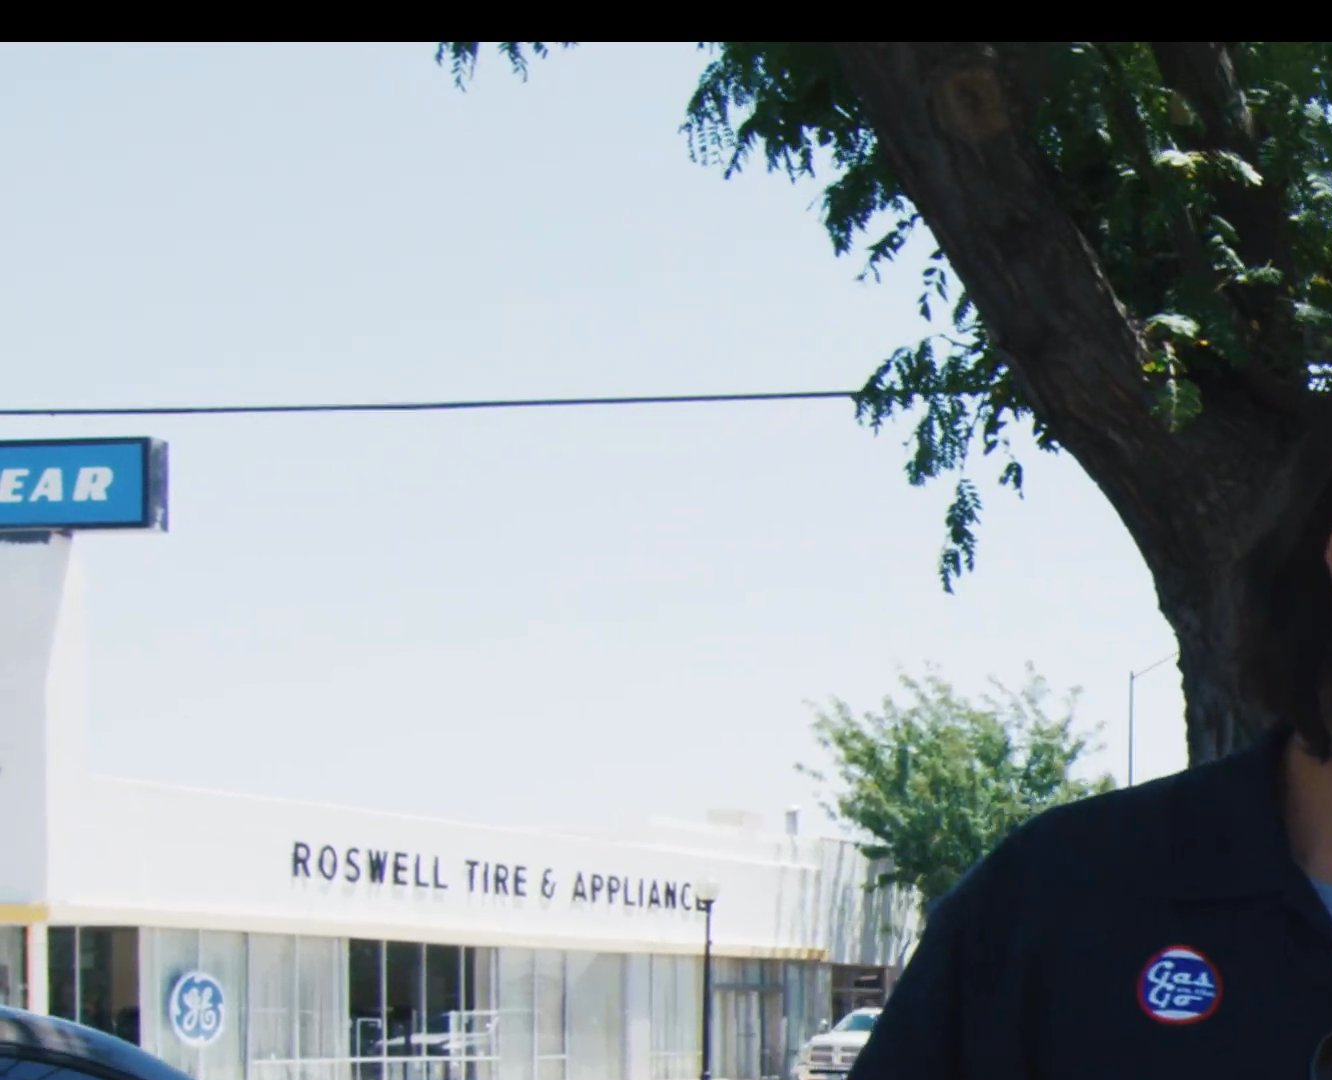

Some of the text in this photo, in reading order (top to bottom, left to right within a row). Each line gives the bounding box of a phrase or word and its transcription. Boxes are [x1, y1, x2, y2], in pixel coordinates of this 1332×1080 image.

[0, 466, 114, 503] EAR
[292, 841, 448, 889] ROSWELL
[465, 859, 527, 898] TIRE
[541, 868, 557, 899] &
[1147, 960, 1214, 988] Gas
[1149, 983, 1203, 1008] Go
